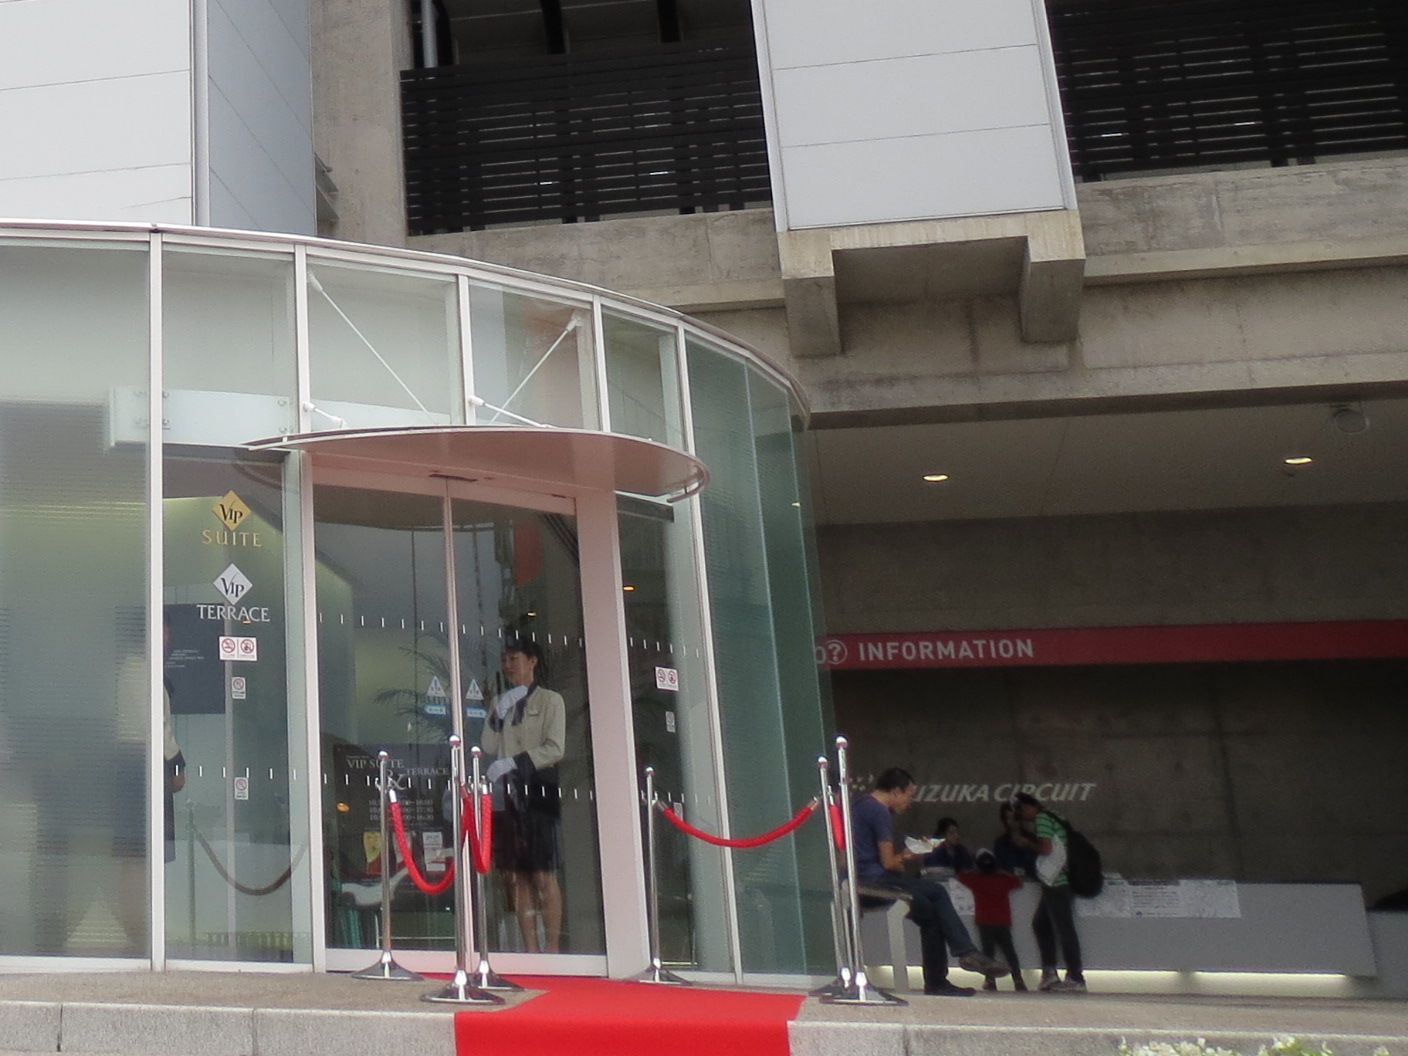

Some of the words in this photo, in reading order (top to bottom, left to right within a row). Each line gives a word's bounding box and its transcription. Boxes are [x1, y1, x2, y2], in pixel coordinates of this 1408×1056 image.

[219, 501, 244, 525] VIP
[201, 529, 262, 547] SUITE
[220, 572, 245, 598] VIP
[196, 604, 270, 622] TERRACE
[858, 639, 1035, 662] INFORMATION
[346, 759, 367, 770] VIP
[369, 758, 405, 770] SUTE
[406, 767, 449, 776] TERRACE
[912, 783, 990, 803] UZUKA
